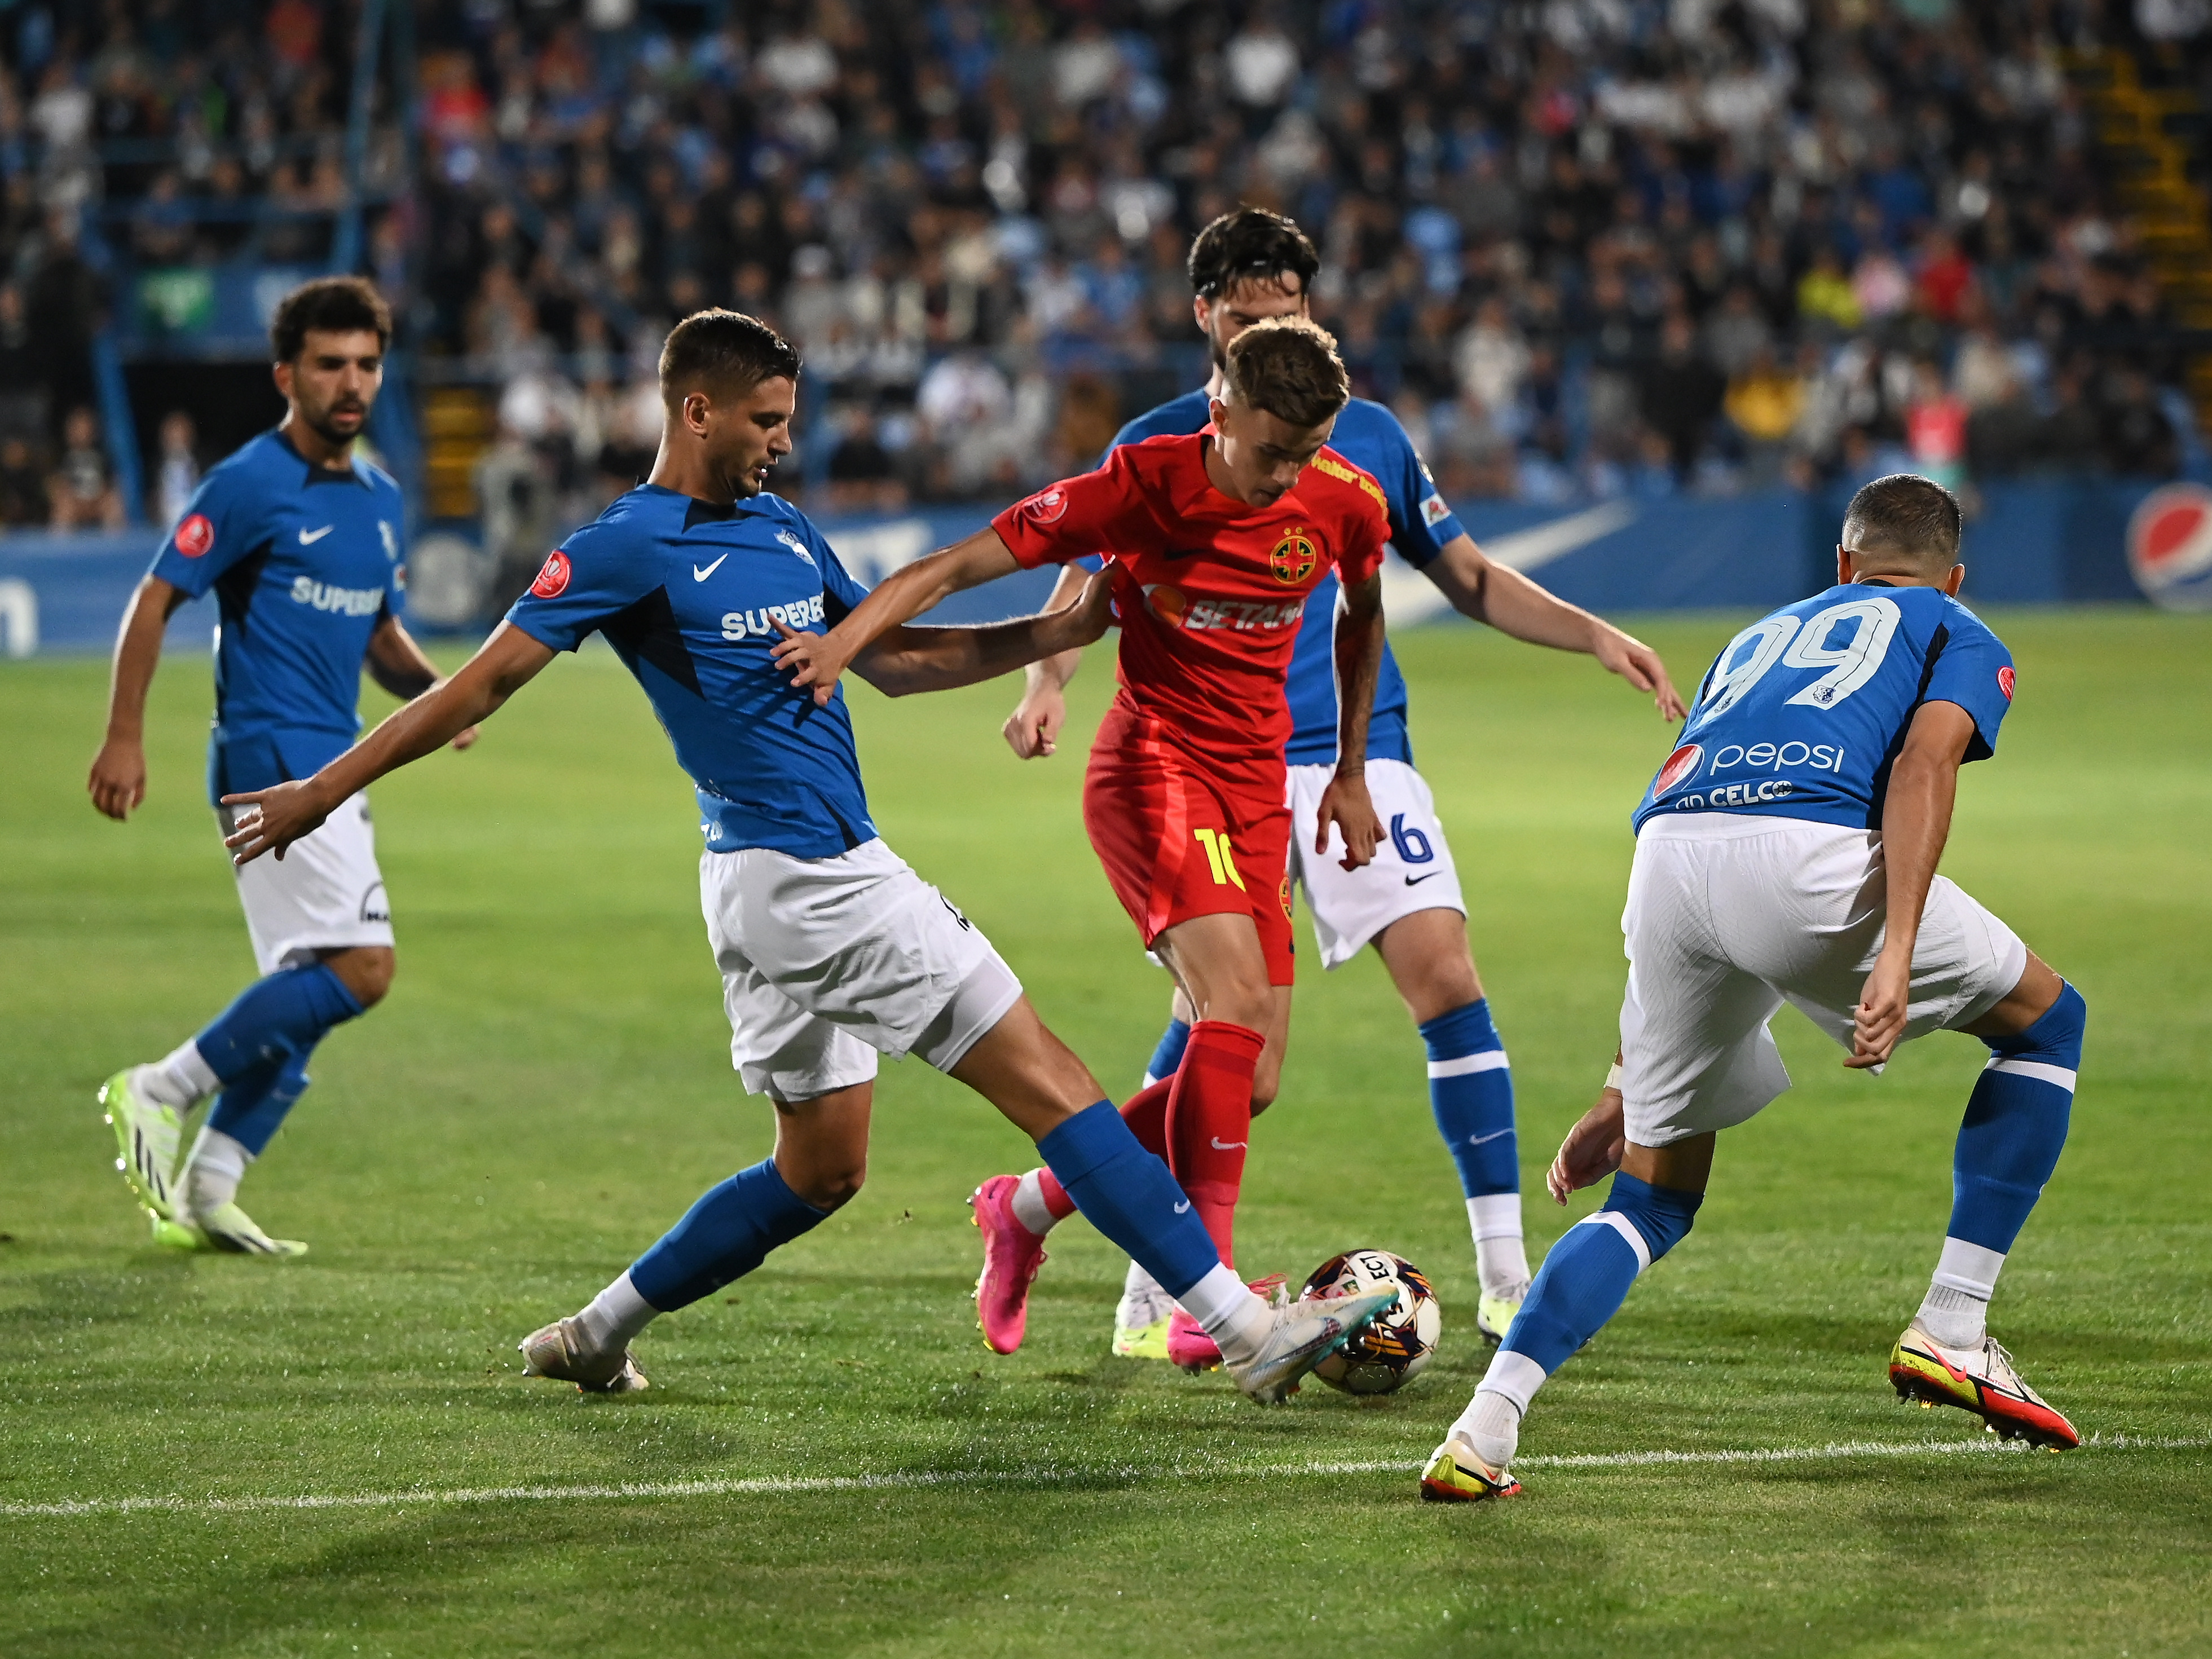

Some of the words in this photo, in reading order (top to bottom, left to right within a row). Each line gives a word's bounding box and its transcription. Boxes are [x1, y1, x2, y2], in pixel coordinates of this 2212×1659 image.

[721, 591, 825, 641] SUPERB
[1696, 597, 1901, 727] 99
[1709, 741, 1844, 776] pepsi
[1391, 813, 1434, 863] 6
